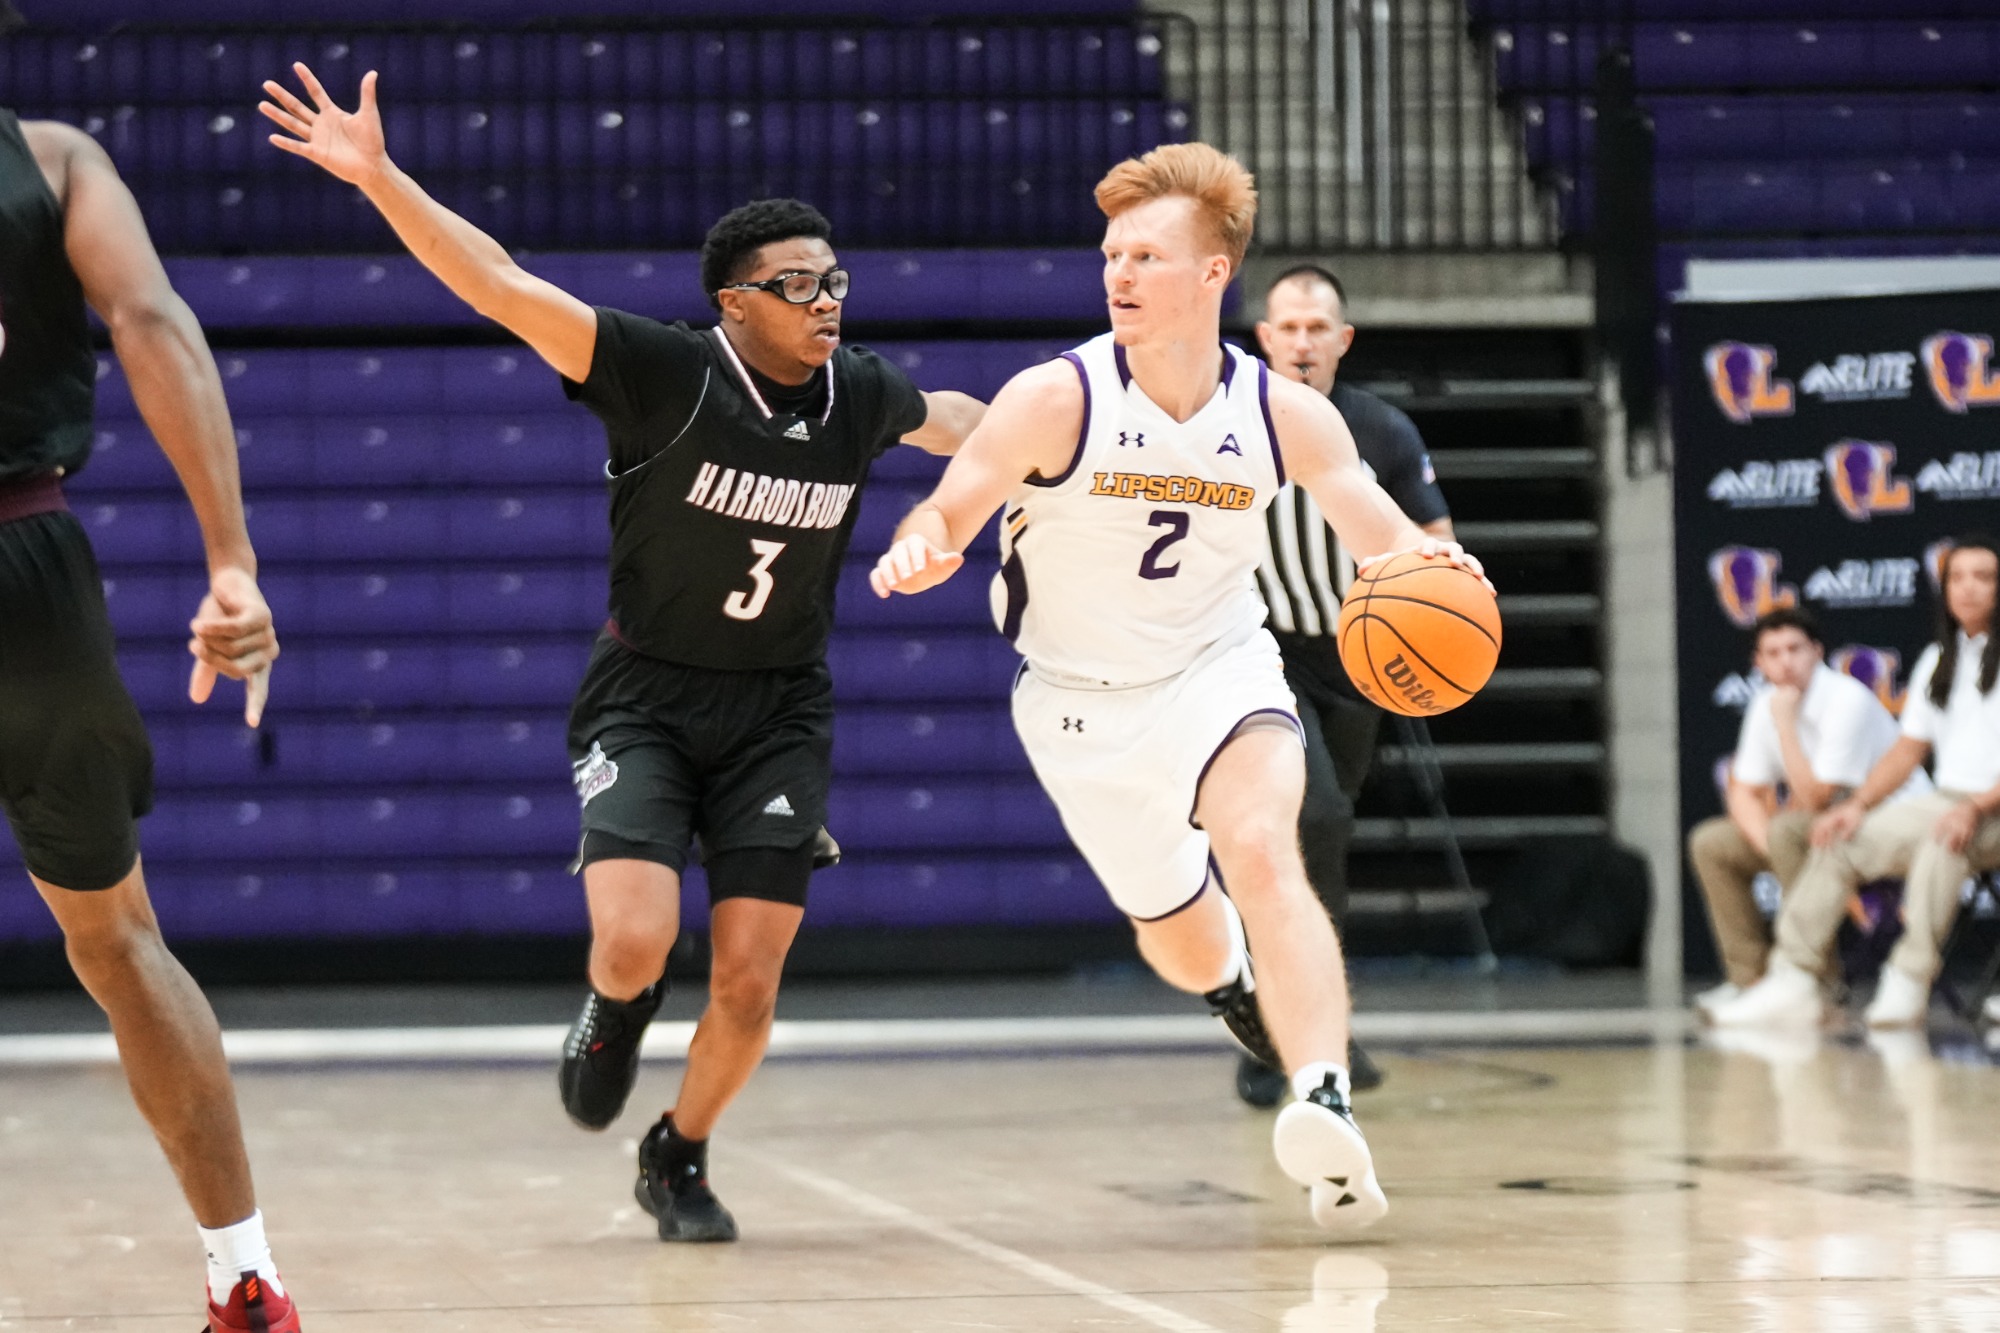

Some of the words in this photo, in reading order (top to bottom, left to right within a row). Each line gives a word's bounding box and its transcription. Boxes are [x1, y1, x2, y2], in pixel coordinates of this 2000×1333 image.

[1089, 472, 1255, 510] LIPSCOMB
[1138, 510, 1190, 580] 2
[722, 538, 787, 620] 3
[1384, 653, 1446, 713] Wilso
